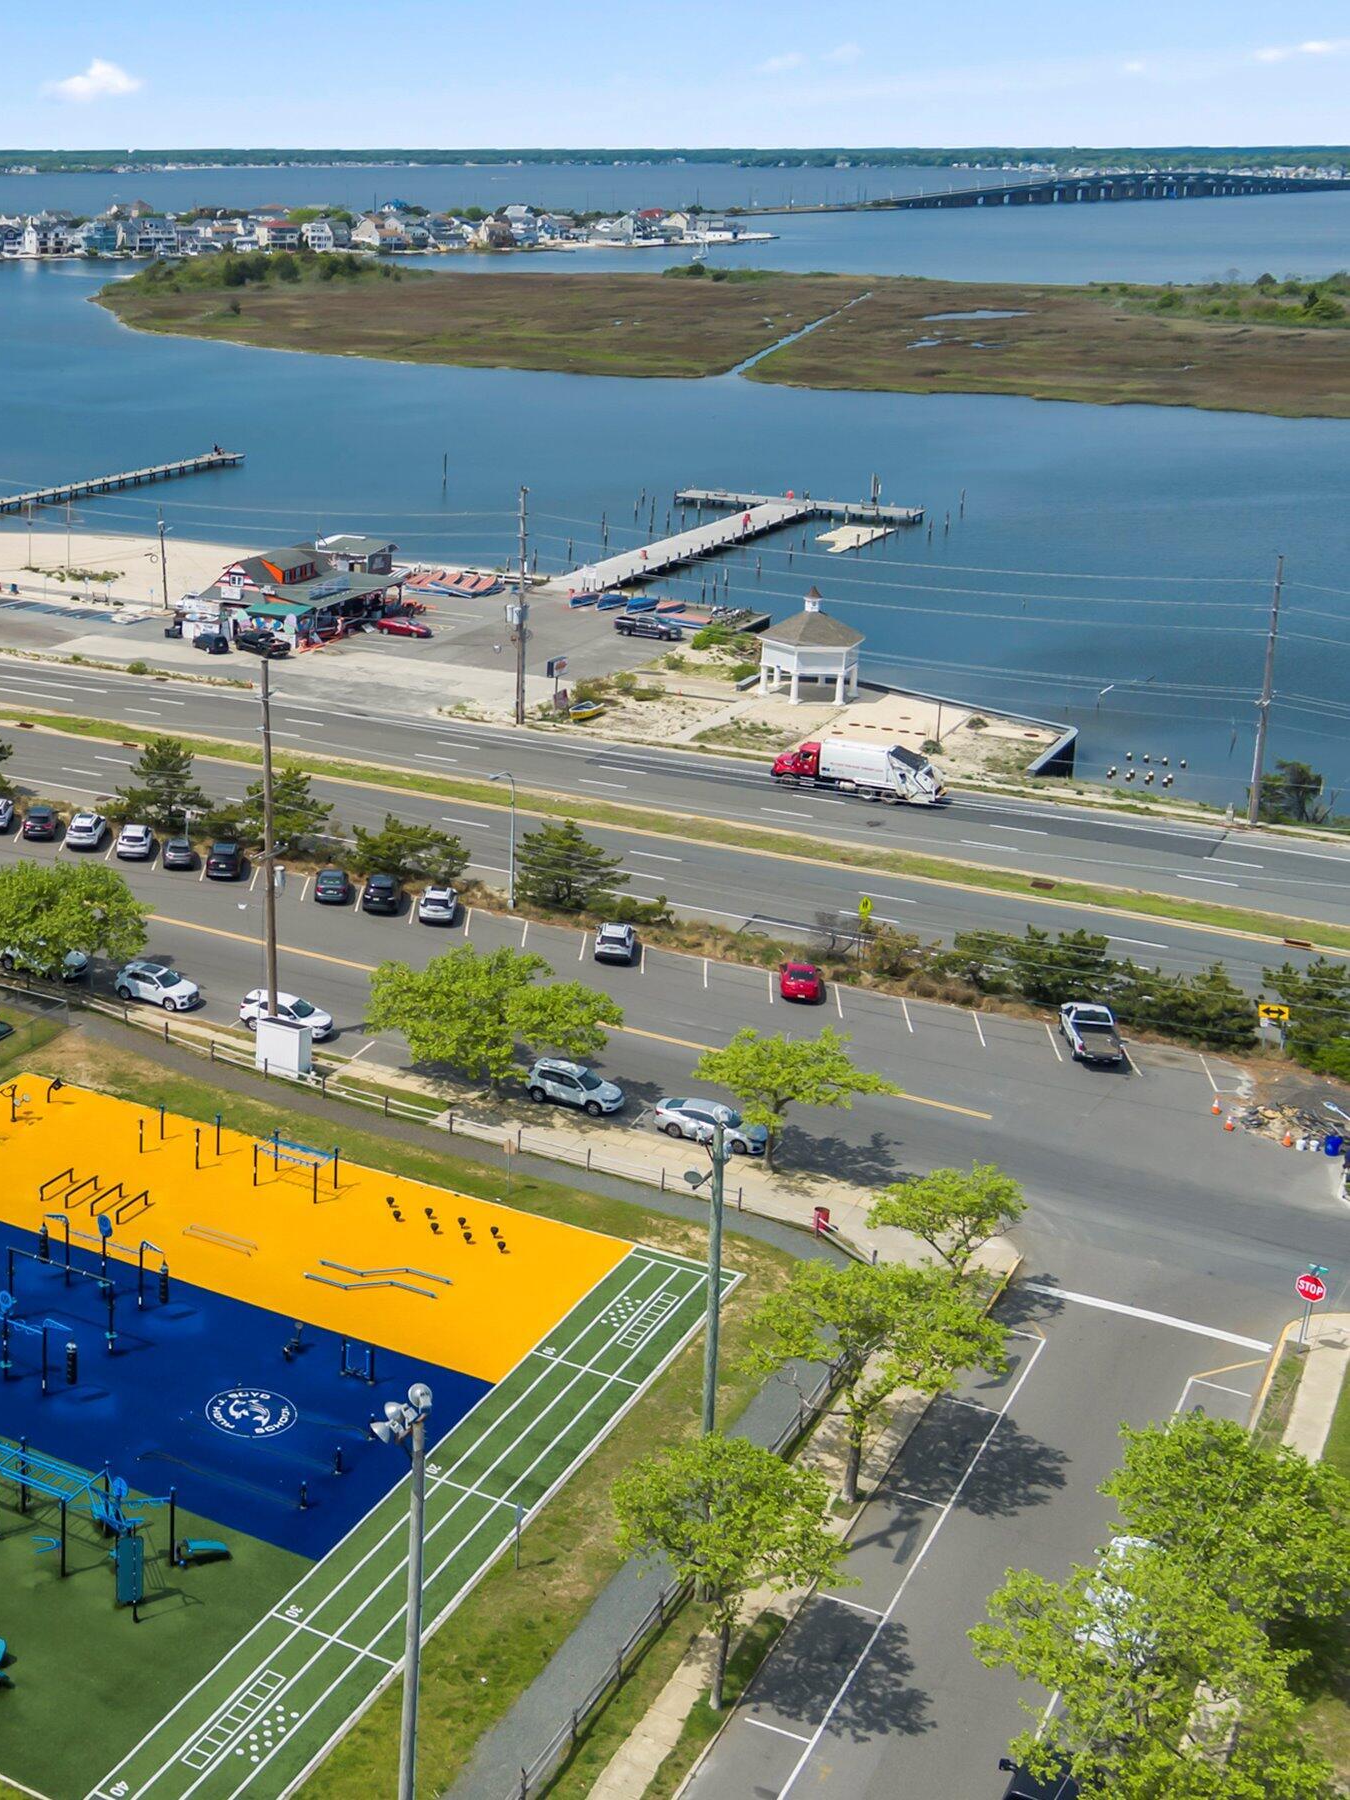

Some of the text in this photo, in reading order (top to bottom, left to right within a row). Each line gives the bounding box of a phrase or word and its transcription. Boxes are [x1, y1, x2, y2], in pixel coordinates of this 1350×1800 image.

[1298, 1280, 1323, 1296] STOP
[426, 1463, 442, 1474] 20
[284, 1604, 304, 1618] 30
[110, 1780, 129, 1797] 40
